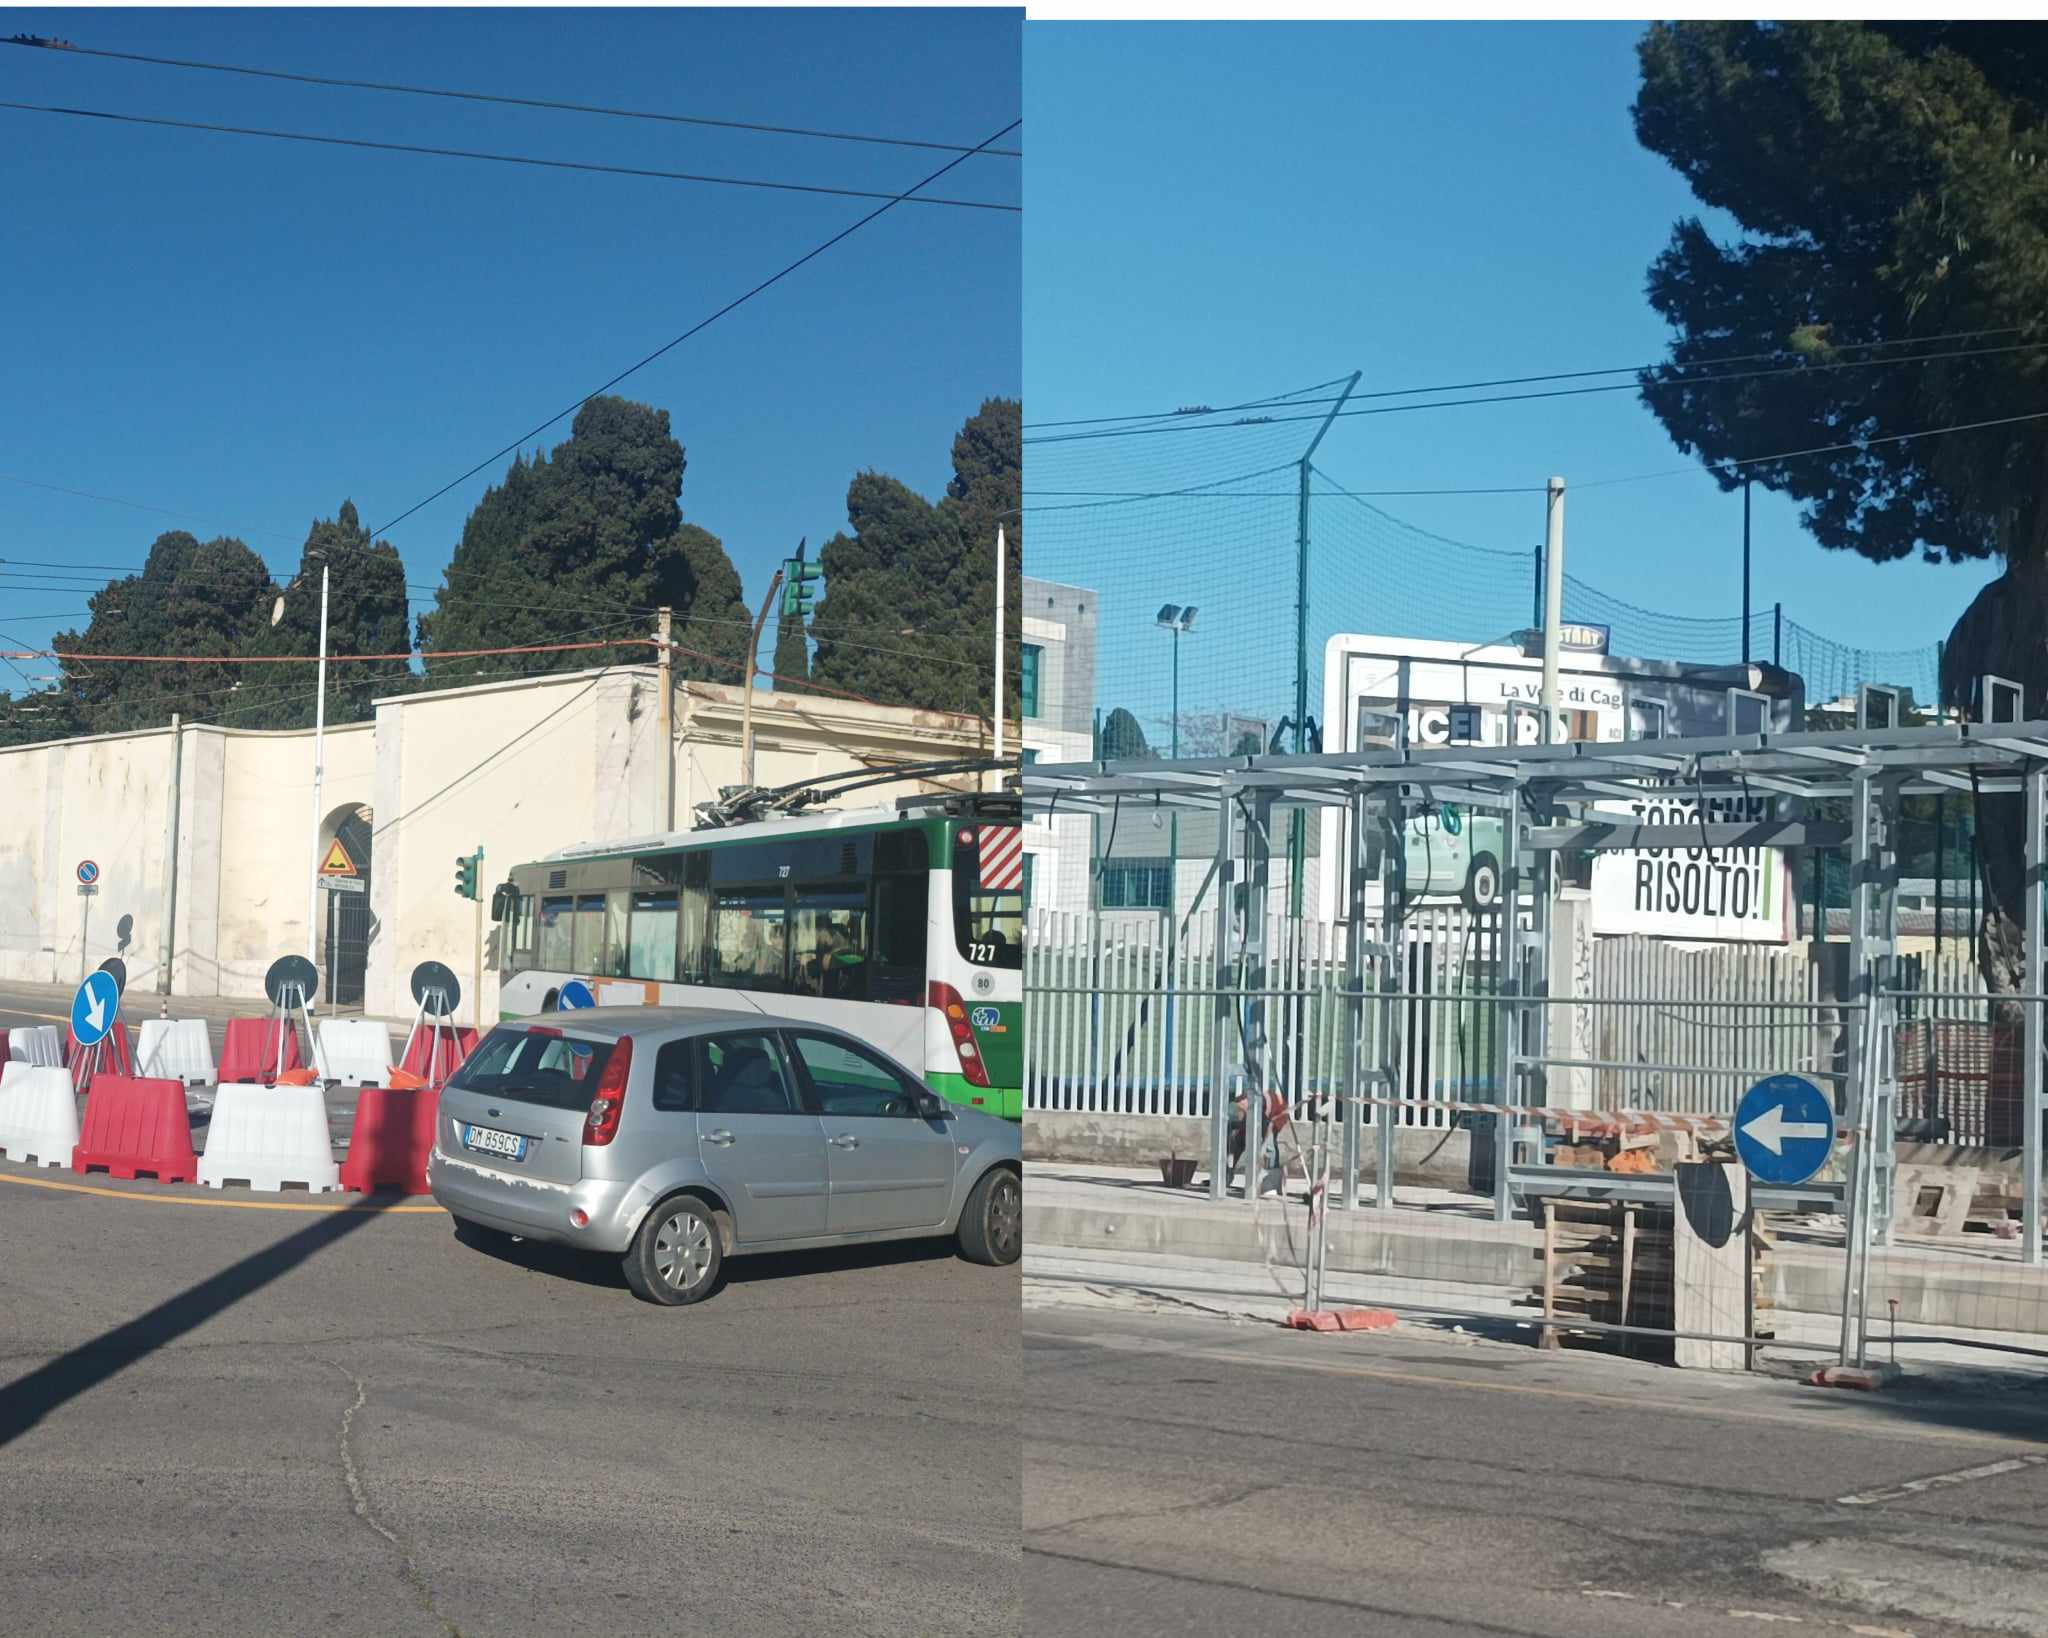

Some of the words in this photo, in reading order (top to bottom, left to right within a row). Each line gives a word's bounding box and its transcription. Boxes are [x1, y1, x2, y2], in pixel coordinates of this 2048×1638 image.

[1500, 683, 1520, 698] La
[1568, 686, 1586, 702] di
[1635, 859, 1760, 920] RISOLTO!
[968, 943, 995, 961] 727
[977, 978, 990, 989] 80
[469, 1127, 483, 1146] DM
[485, 1131, 518, 1153] 859CS
